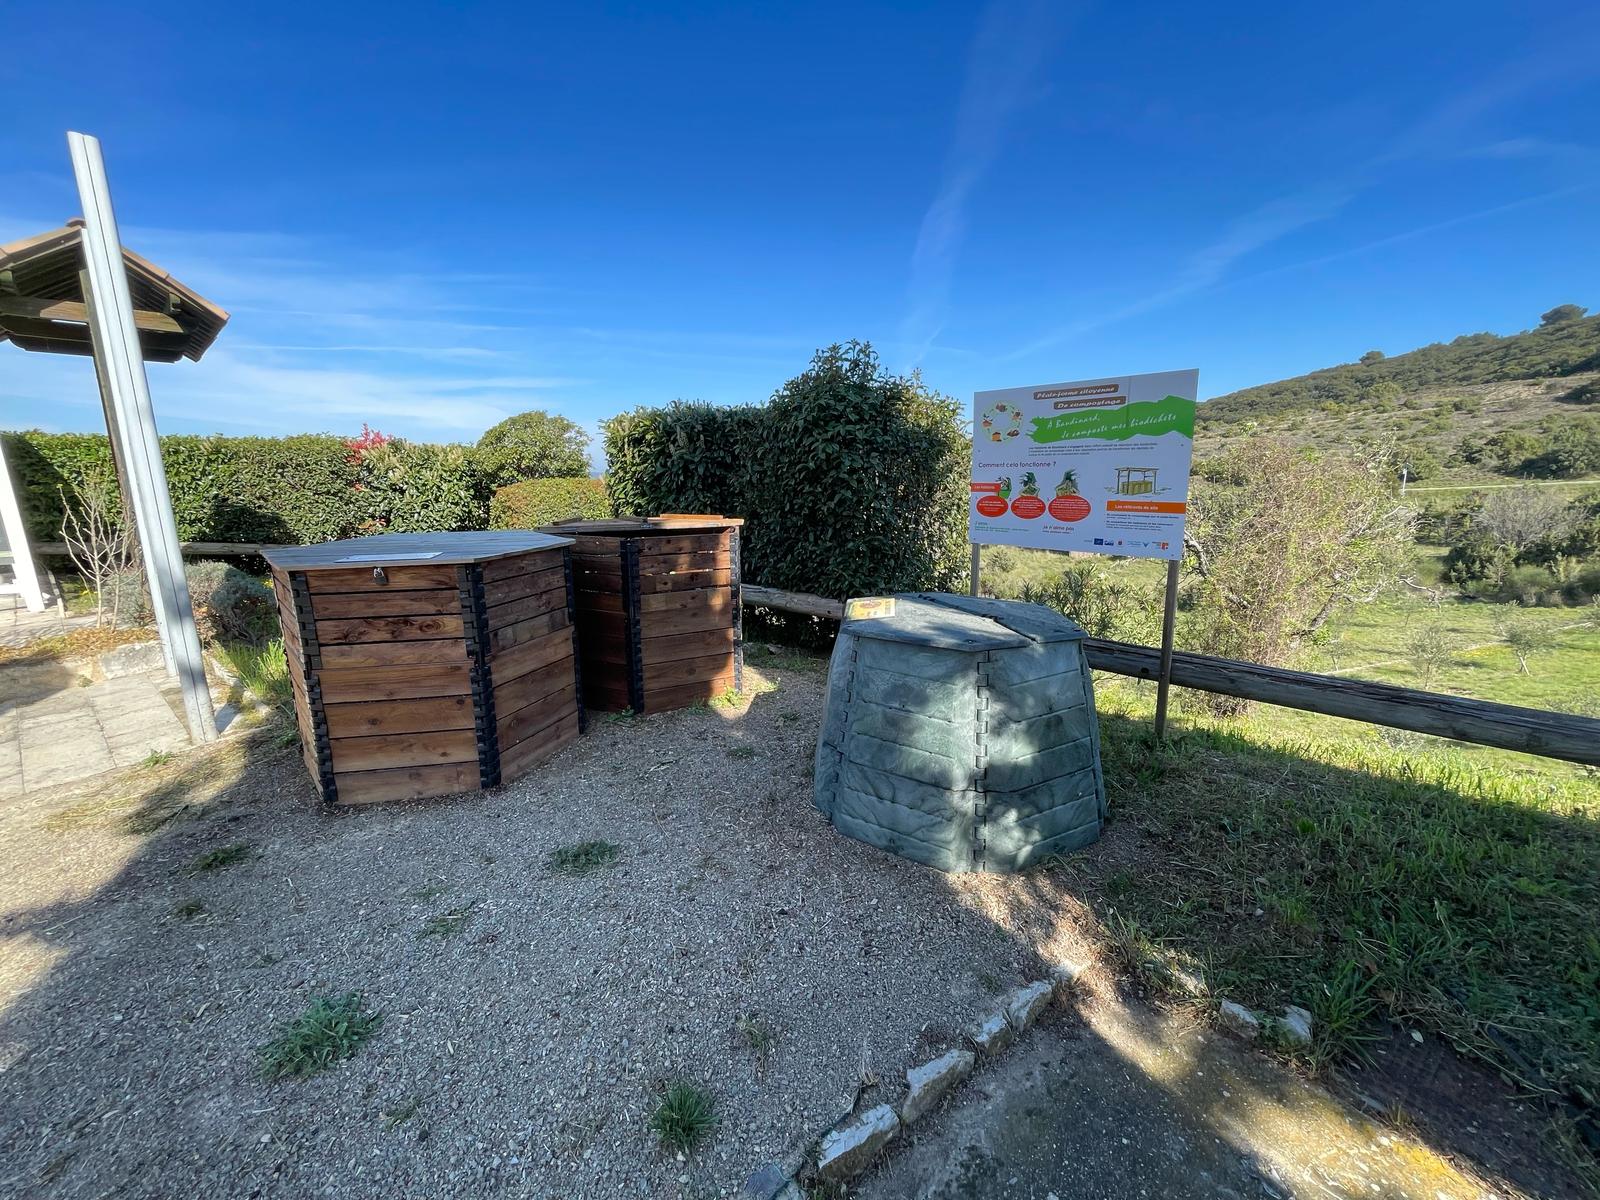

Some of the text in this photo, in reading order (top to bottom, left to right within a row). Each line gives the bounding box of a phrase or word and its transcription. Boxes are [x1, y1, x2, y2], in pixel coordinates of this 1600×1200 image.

[1080, 386, 1115, 396] citoyenne
[1070, 398, 1121, 408] compostage
[1072, 424, 1108, 438] composte
[1111, 422, 1126, 430] mes
